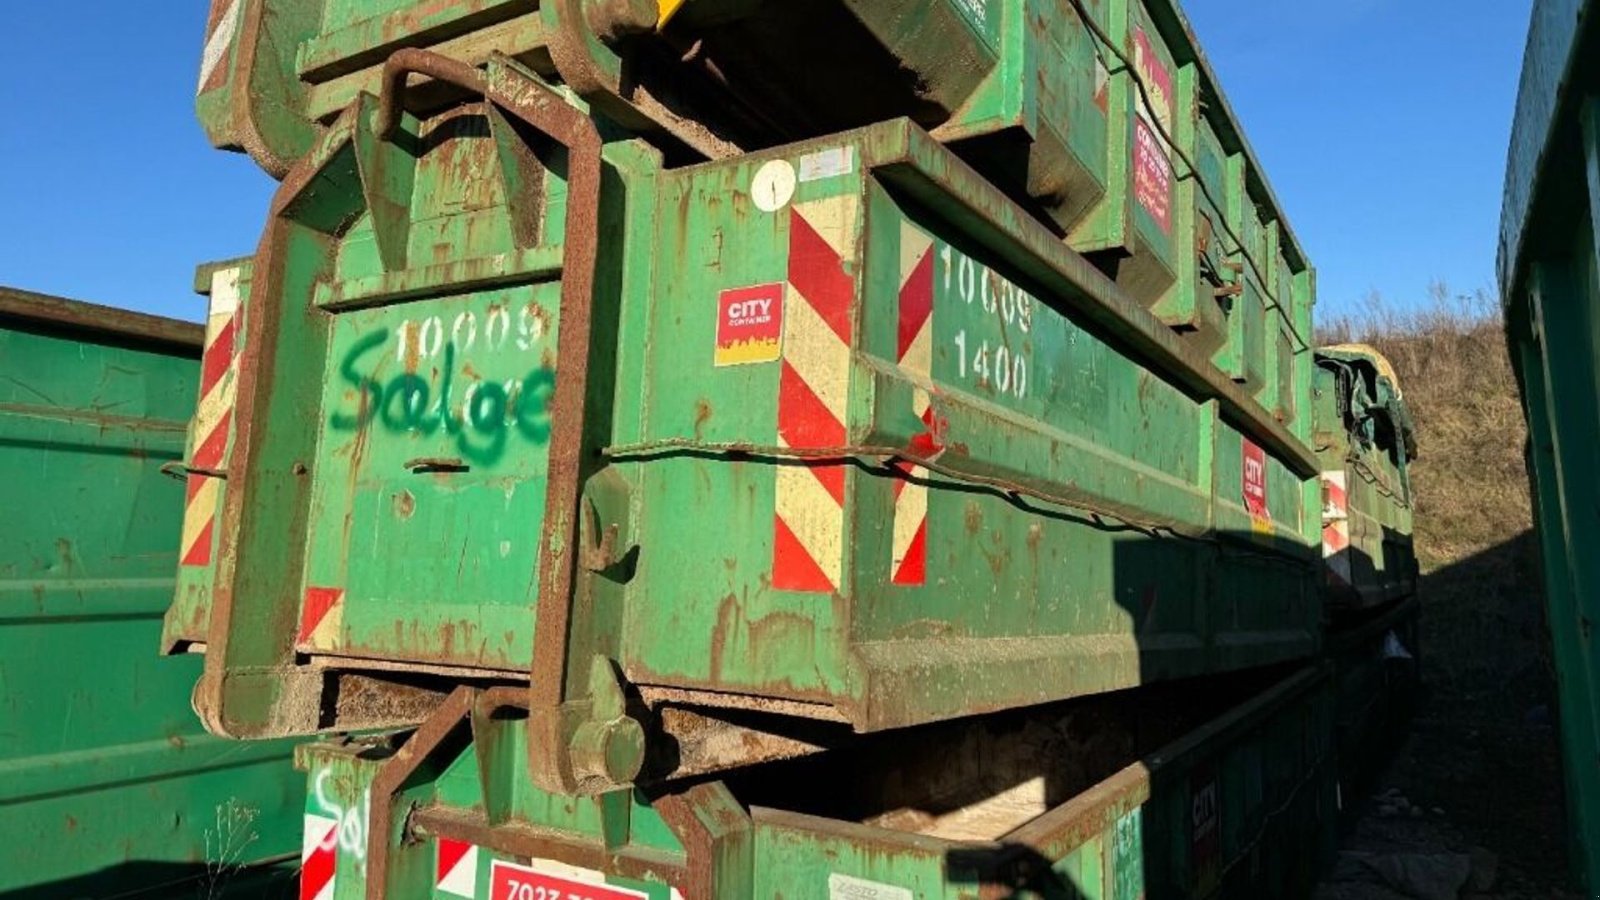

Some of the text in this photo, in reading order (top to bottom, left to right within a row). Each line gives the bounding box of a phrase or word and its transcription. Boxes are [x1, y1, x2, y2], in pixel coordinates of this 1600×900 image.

[728, 298, 772, 318] CITY
[396, 304, 543, 361] 10009
[955, 329, 1027, 399] 1400
[1245, 455, 1262, 486] CITY
